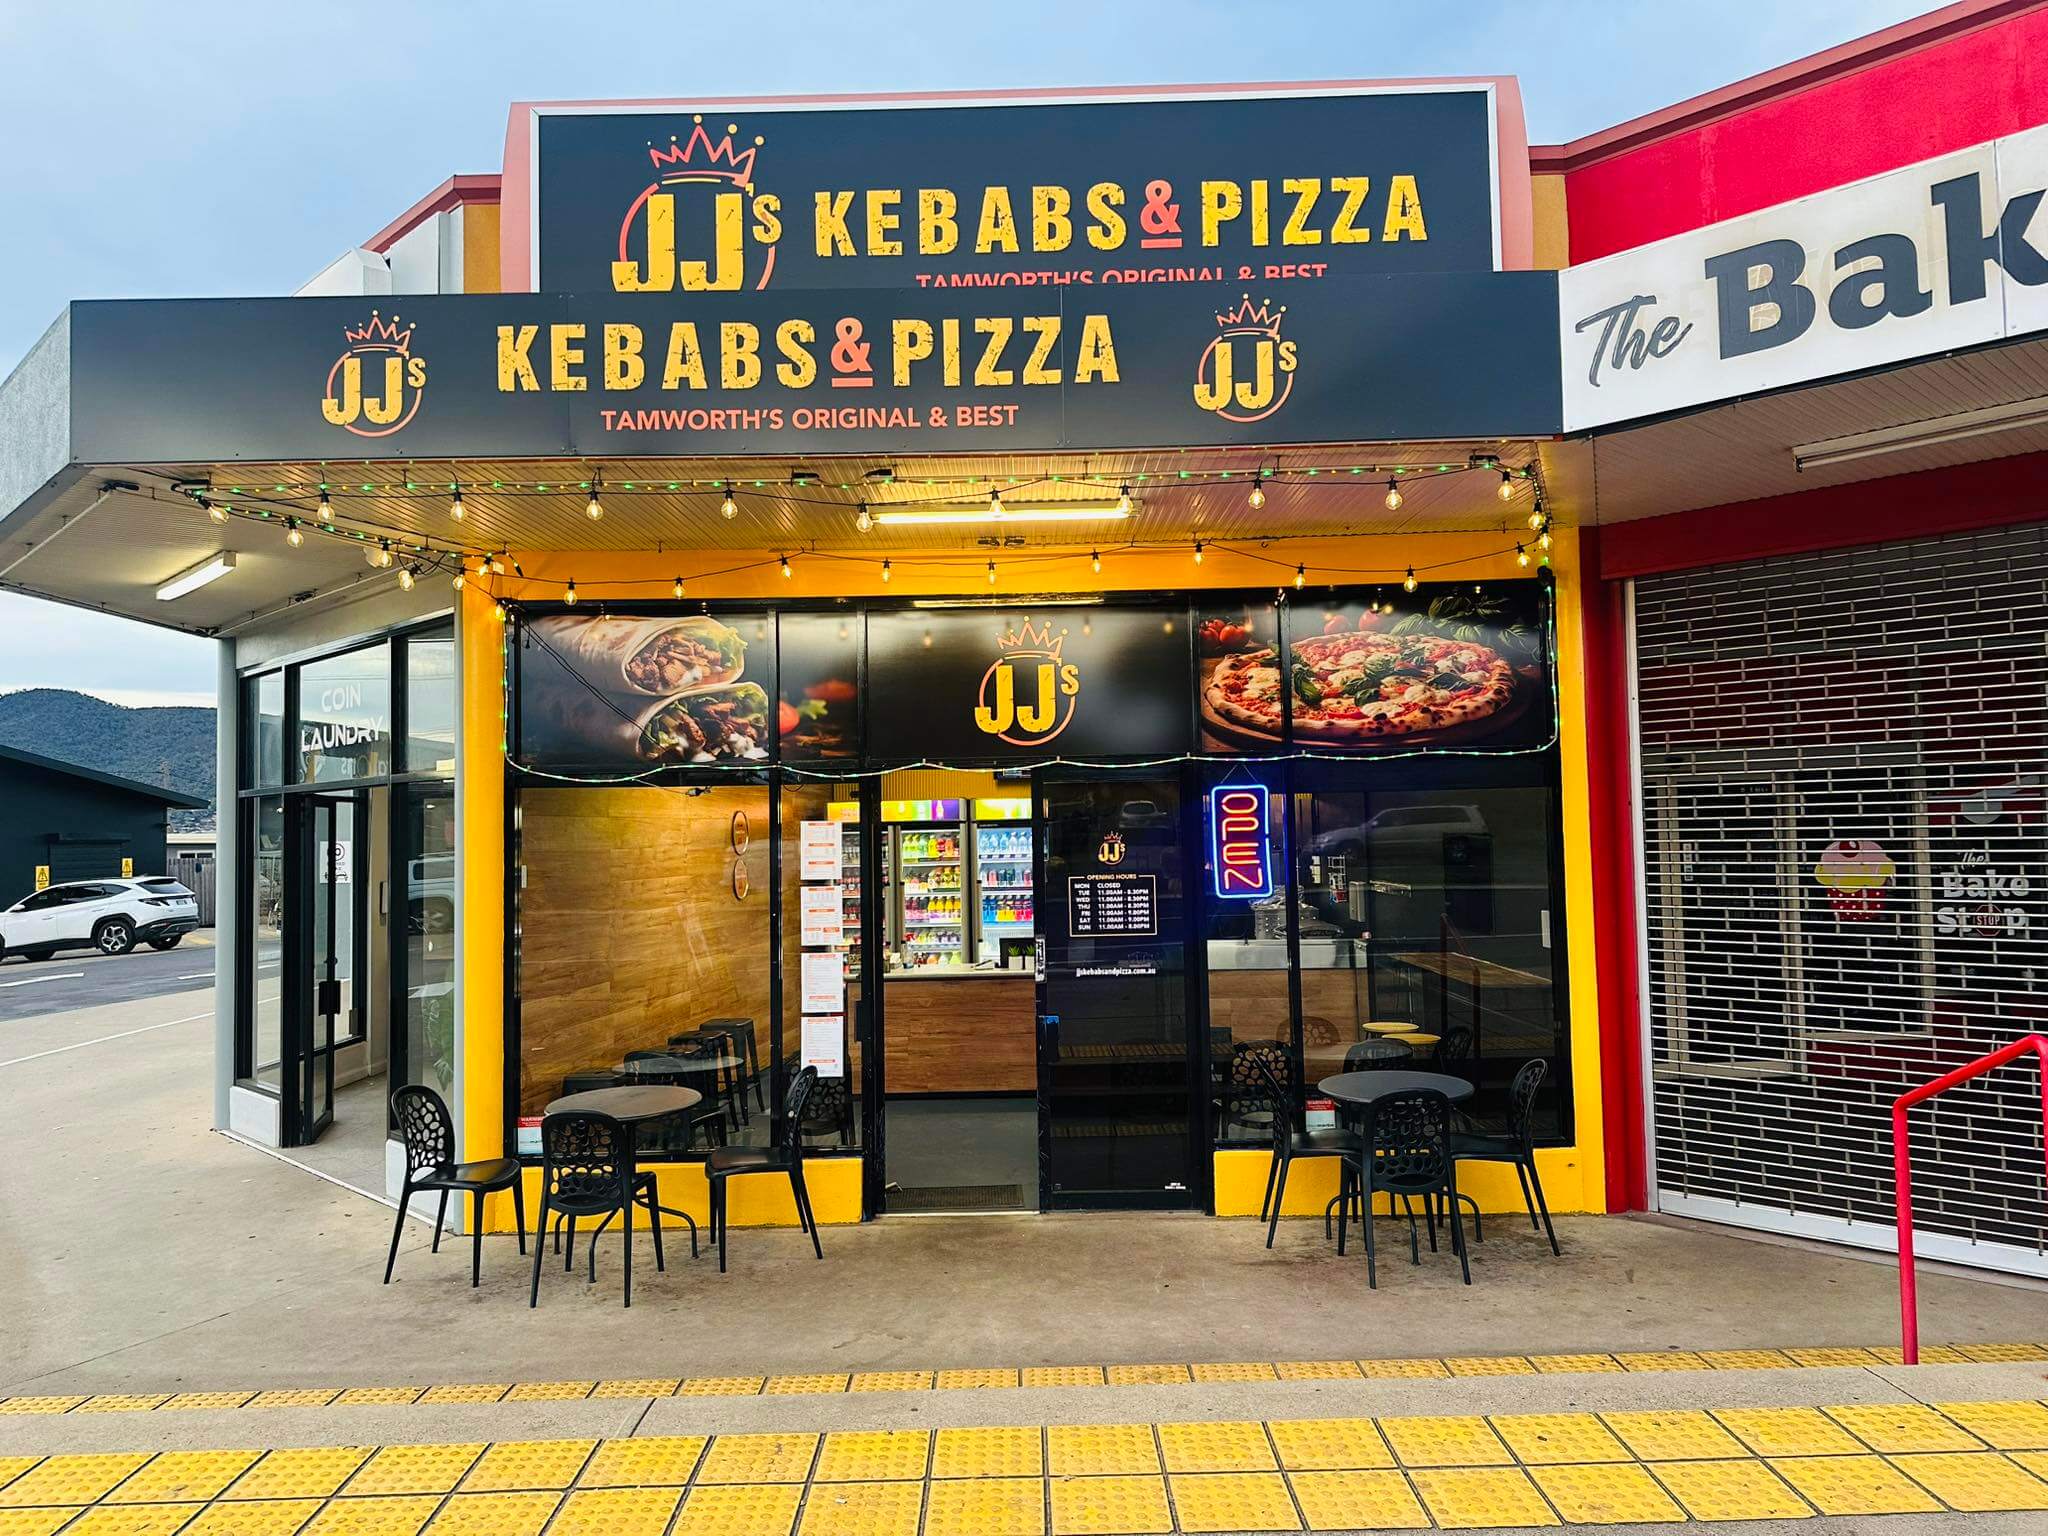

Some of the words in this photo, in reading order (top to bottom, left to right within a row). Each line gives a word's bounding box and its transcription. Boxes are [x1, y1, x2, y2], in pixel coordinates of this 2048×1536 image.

[814, 182, 1127, 257] KEBABS
[1139, 178, 1183, 235] &
[1200, 174, 1428, 248] PIZZA
[497, 318, 817, 392] KEBABS
[830, 316, 874, 374] &
[892, 314, 1121, 388] PIZZA
[1574, 295, 1694, 388] The
[600, 408, 784, 432] TAMWORTH'S
[792, 406, 921, 430] ORIGINAL
[929, 407, 949, 428] &
[955, 405, 1019, 428] BEST
[321, 682, 361, 712] COIN
[300, 716, 384, 752] LAUNDRY
[1222, 793, 1263, 889] OPEN
[1940, 869, 2030, 897] Bake
[1076, 967, 1156, 977] jjskebabsandpizza.com.au
